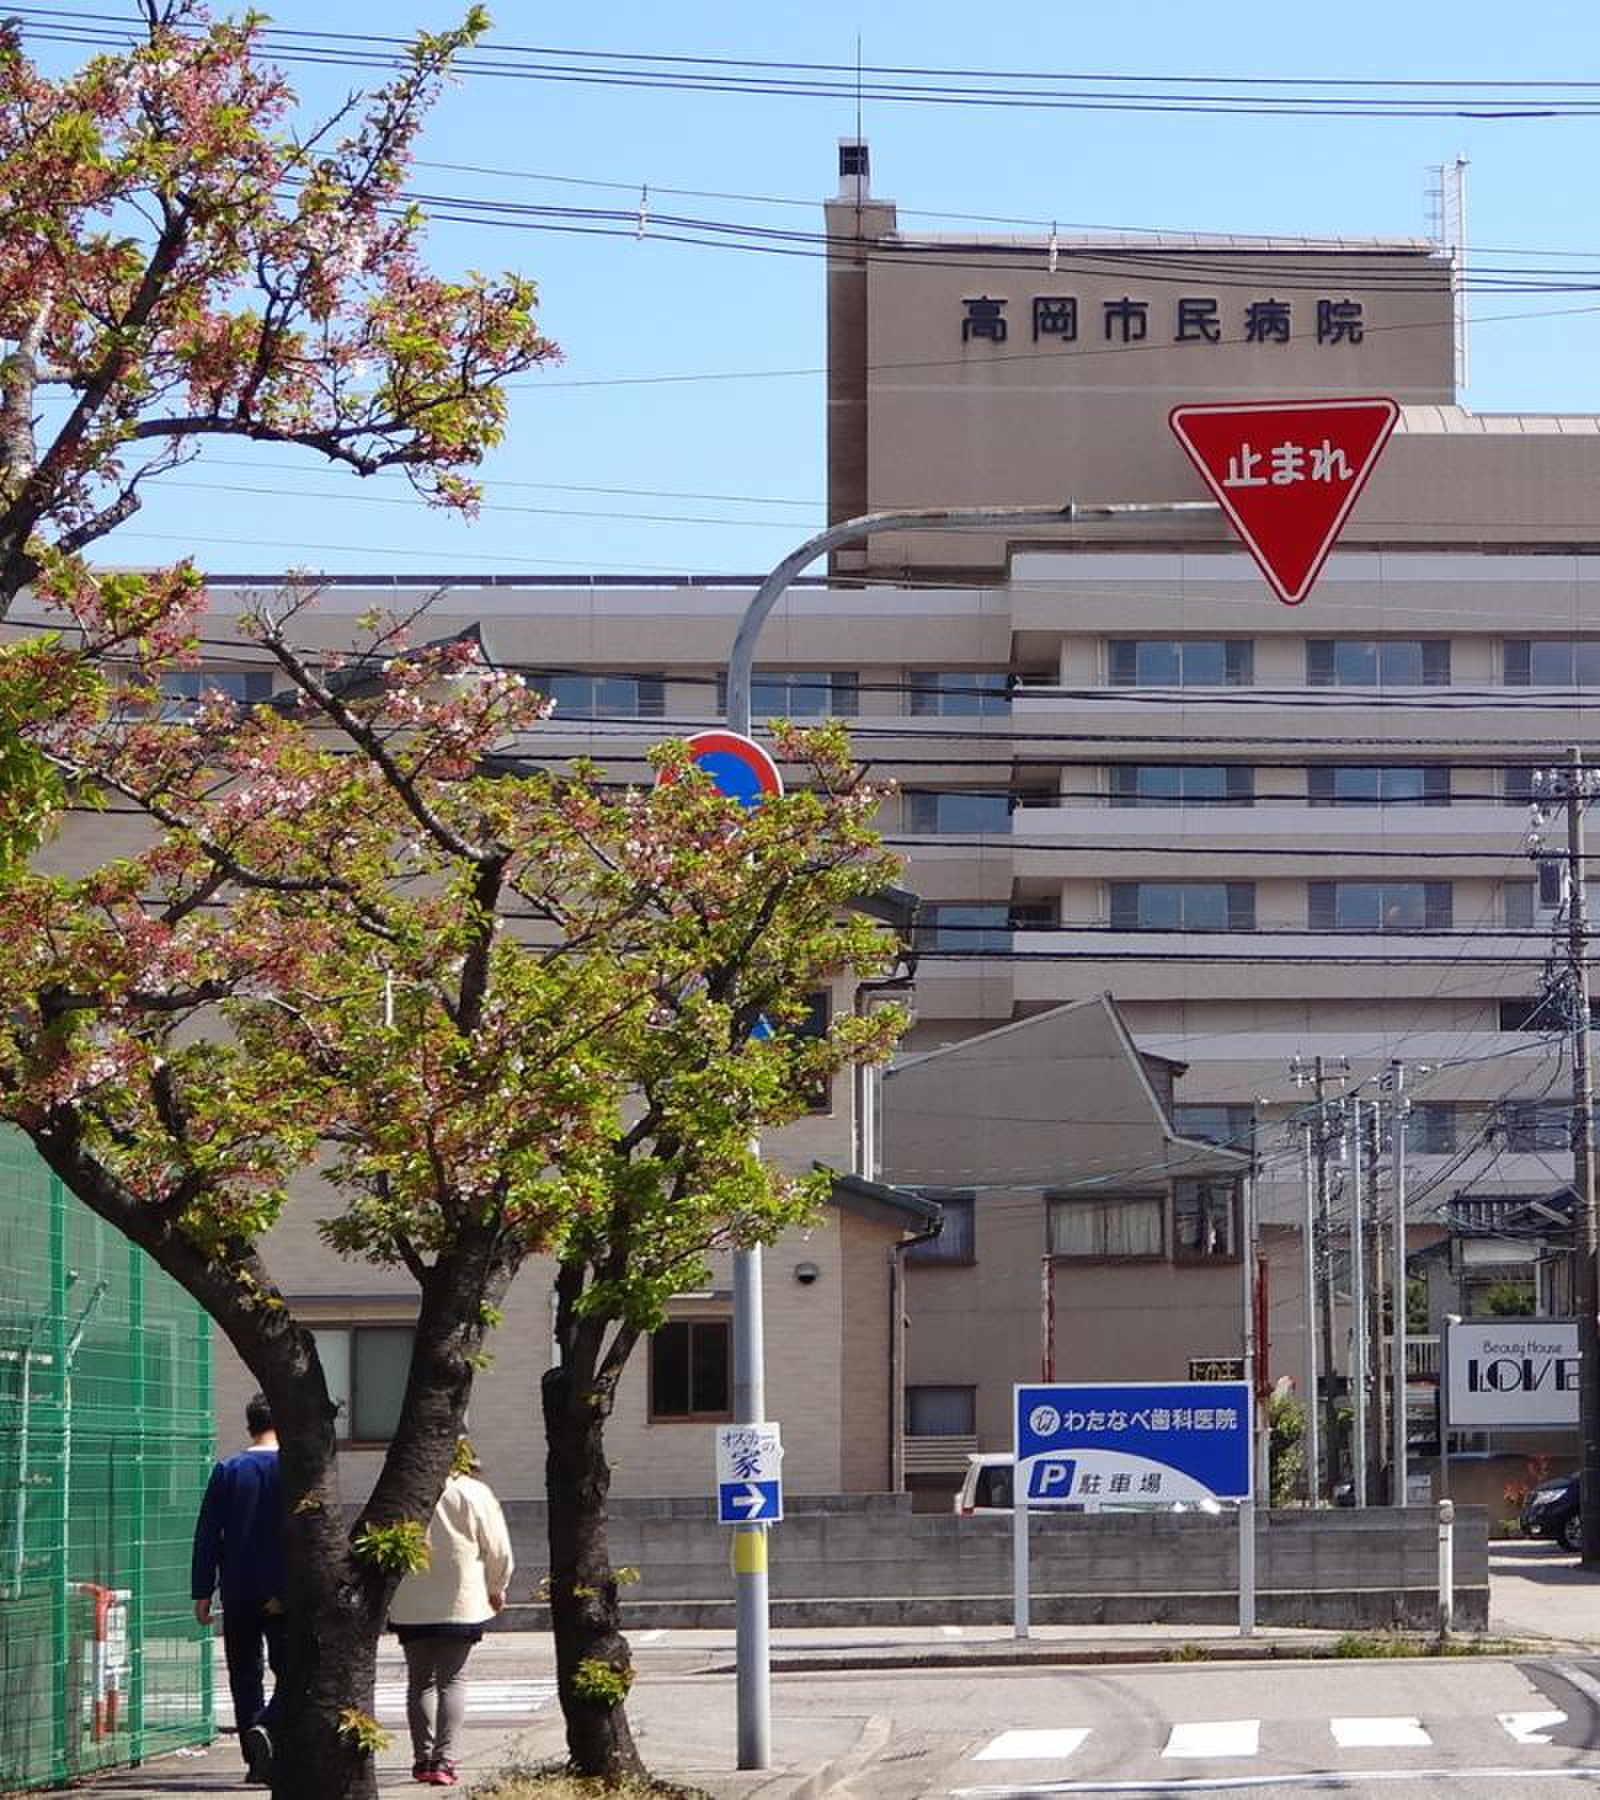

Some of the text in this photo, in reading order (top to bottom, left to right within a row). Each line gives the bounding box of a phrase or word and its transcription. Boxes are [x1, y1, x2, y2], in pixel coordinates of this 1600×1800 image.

[961, 295, 1365, 344] 高岡市民病院
[1221, 440, 1354, 487] 止まれ
[1483, 1340, 1563, 1357] Beauty House
[1468, 1358, 1581, 1392] LOVE
[1063, 1407, 1239, 1432] わたなべ歯科医院
[1040, 1464, 1163, 1495] P 駐車場
